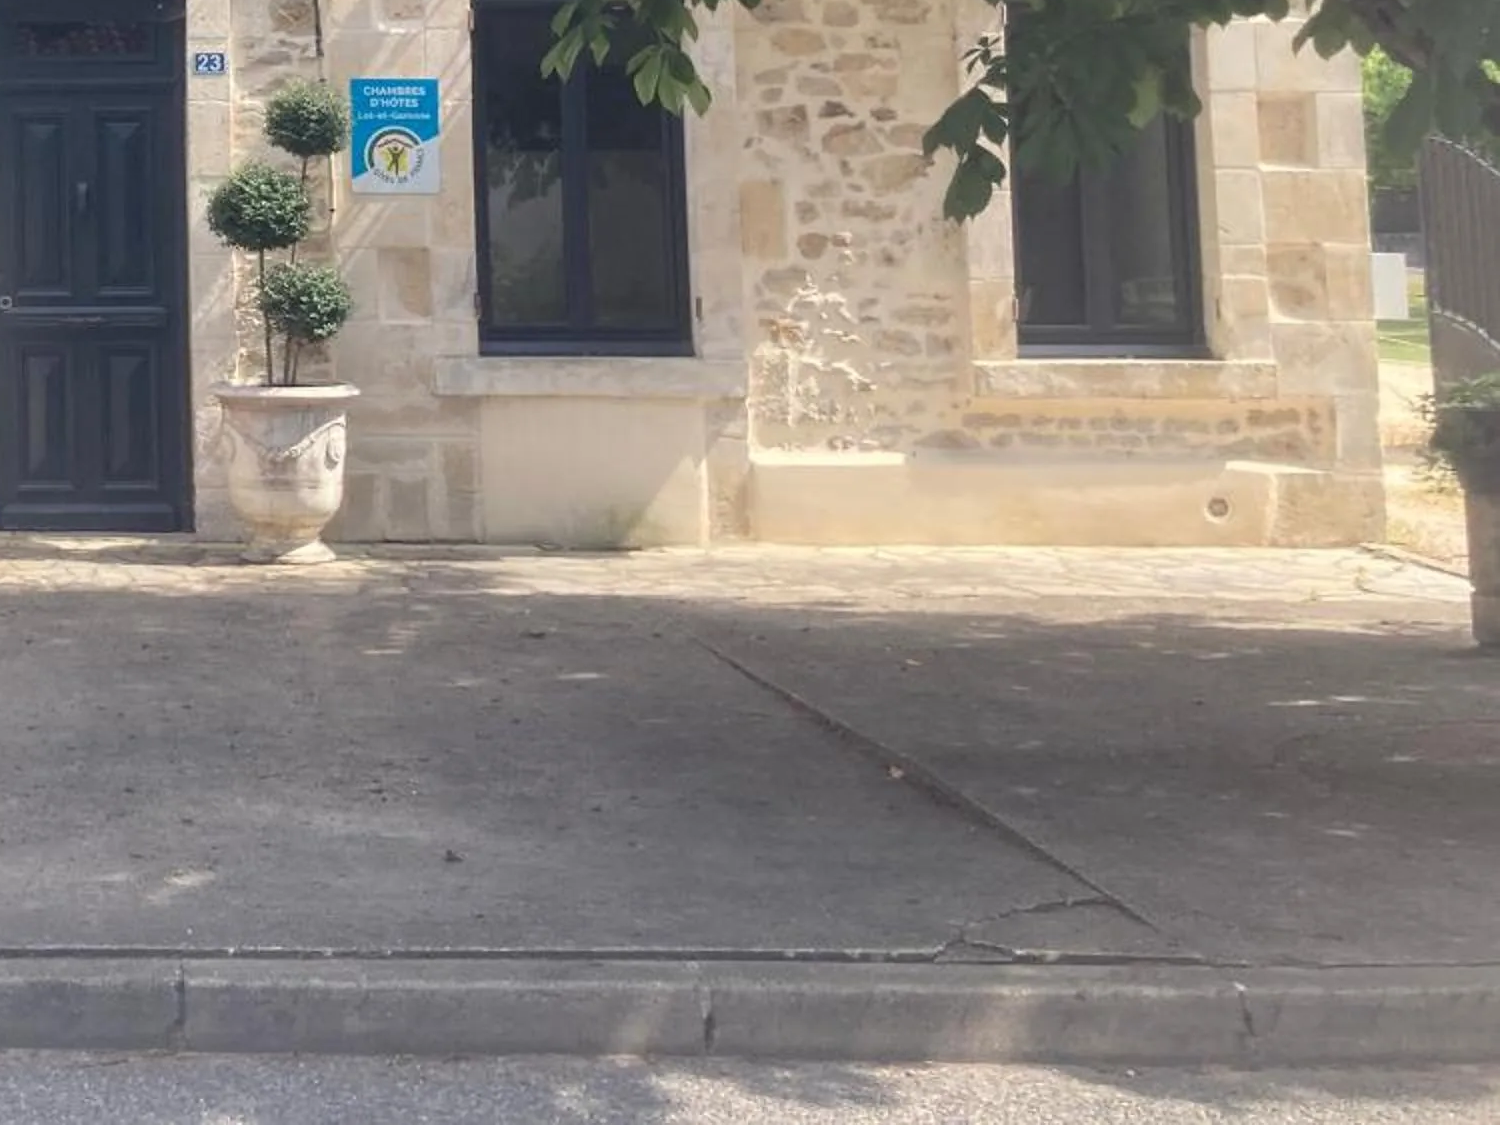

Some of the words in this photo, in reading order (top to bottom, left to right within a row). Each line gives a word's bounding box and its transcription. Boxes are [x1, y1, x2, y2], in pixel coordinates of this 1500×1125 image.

[198, 54, 221, 71] 23
[363, 86, 426, 96] CHAMBRES
[369, 96, 419, 108] D'HÔTES
